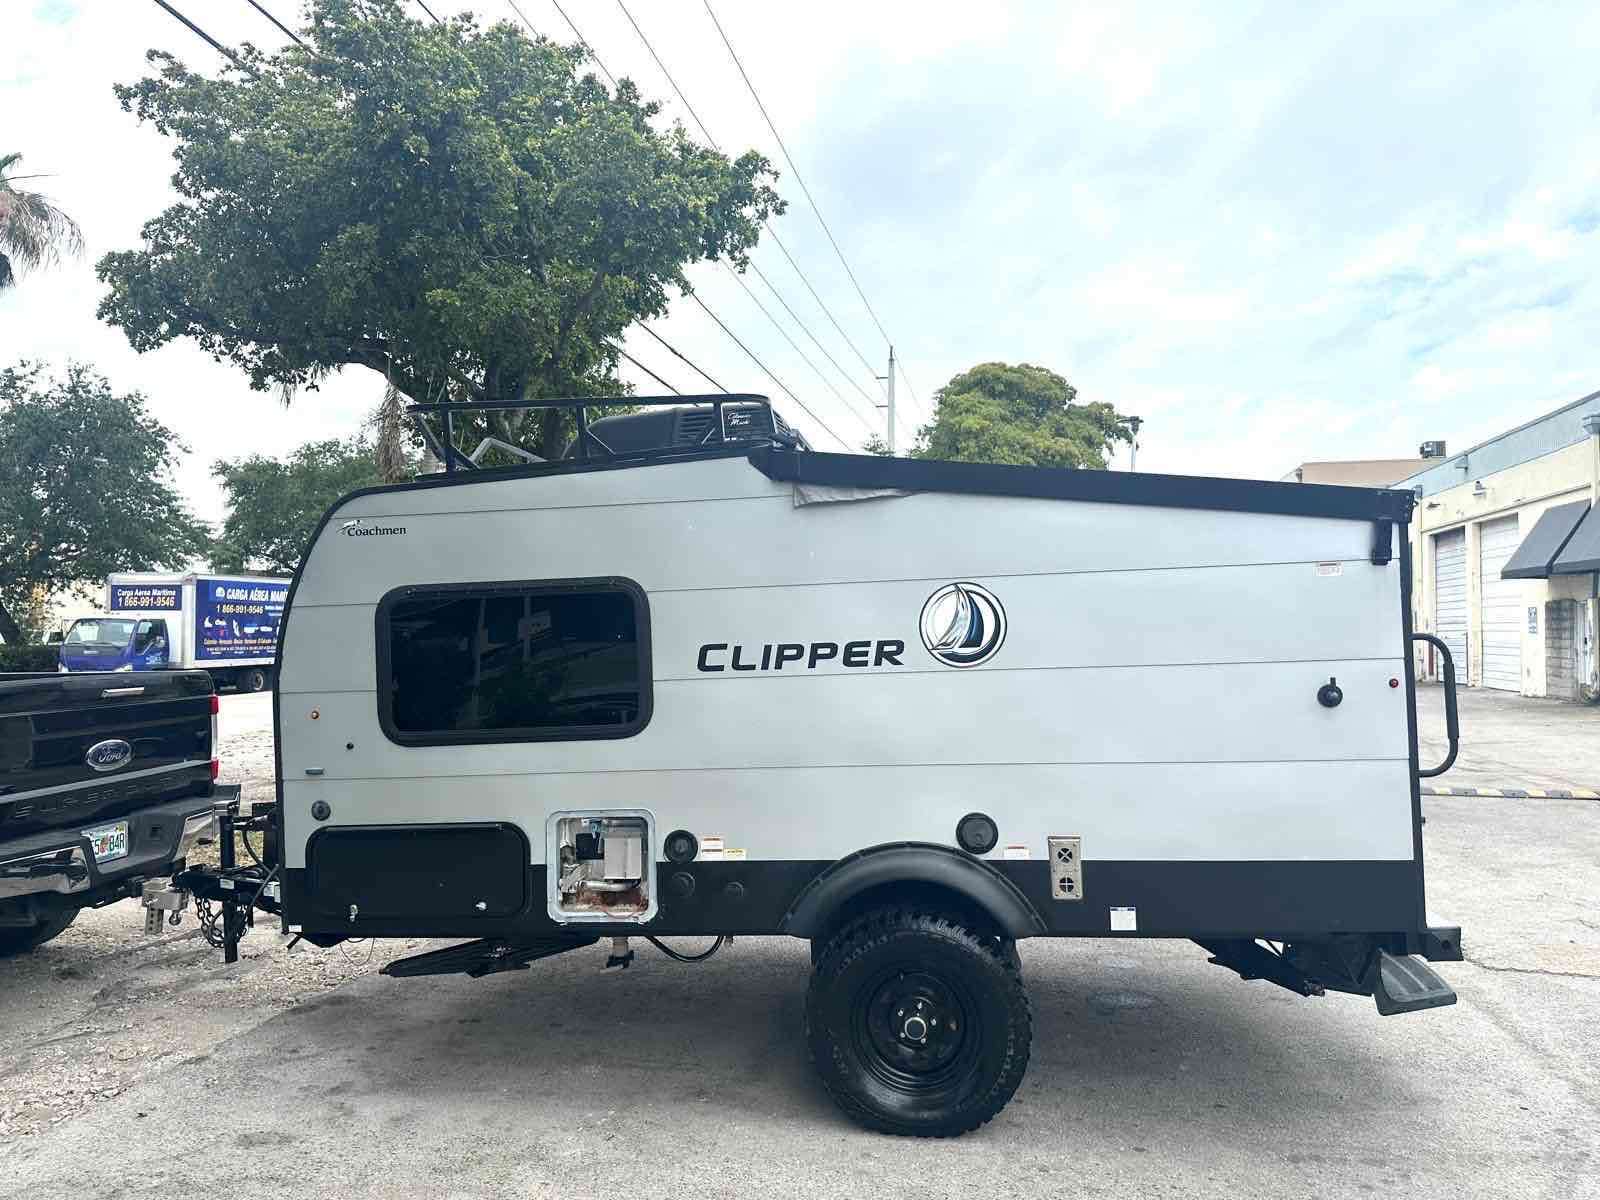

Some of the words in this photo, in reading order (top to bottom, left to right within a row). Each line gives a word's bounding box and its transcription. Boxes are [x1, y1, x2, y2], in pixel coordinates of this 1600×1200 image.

[347, 526, 407, 537] Coachmen
[117, 588, 134, 597] Carga
[226, 588, 248, 601] CARGA
[249, 587, 269, 601] AÉREA
[124, 596, 175, 607] 866-991-9546
[697, 639, 905, 672] CLIPPER
